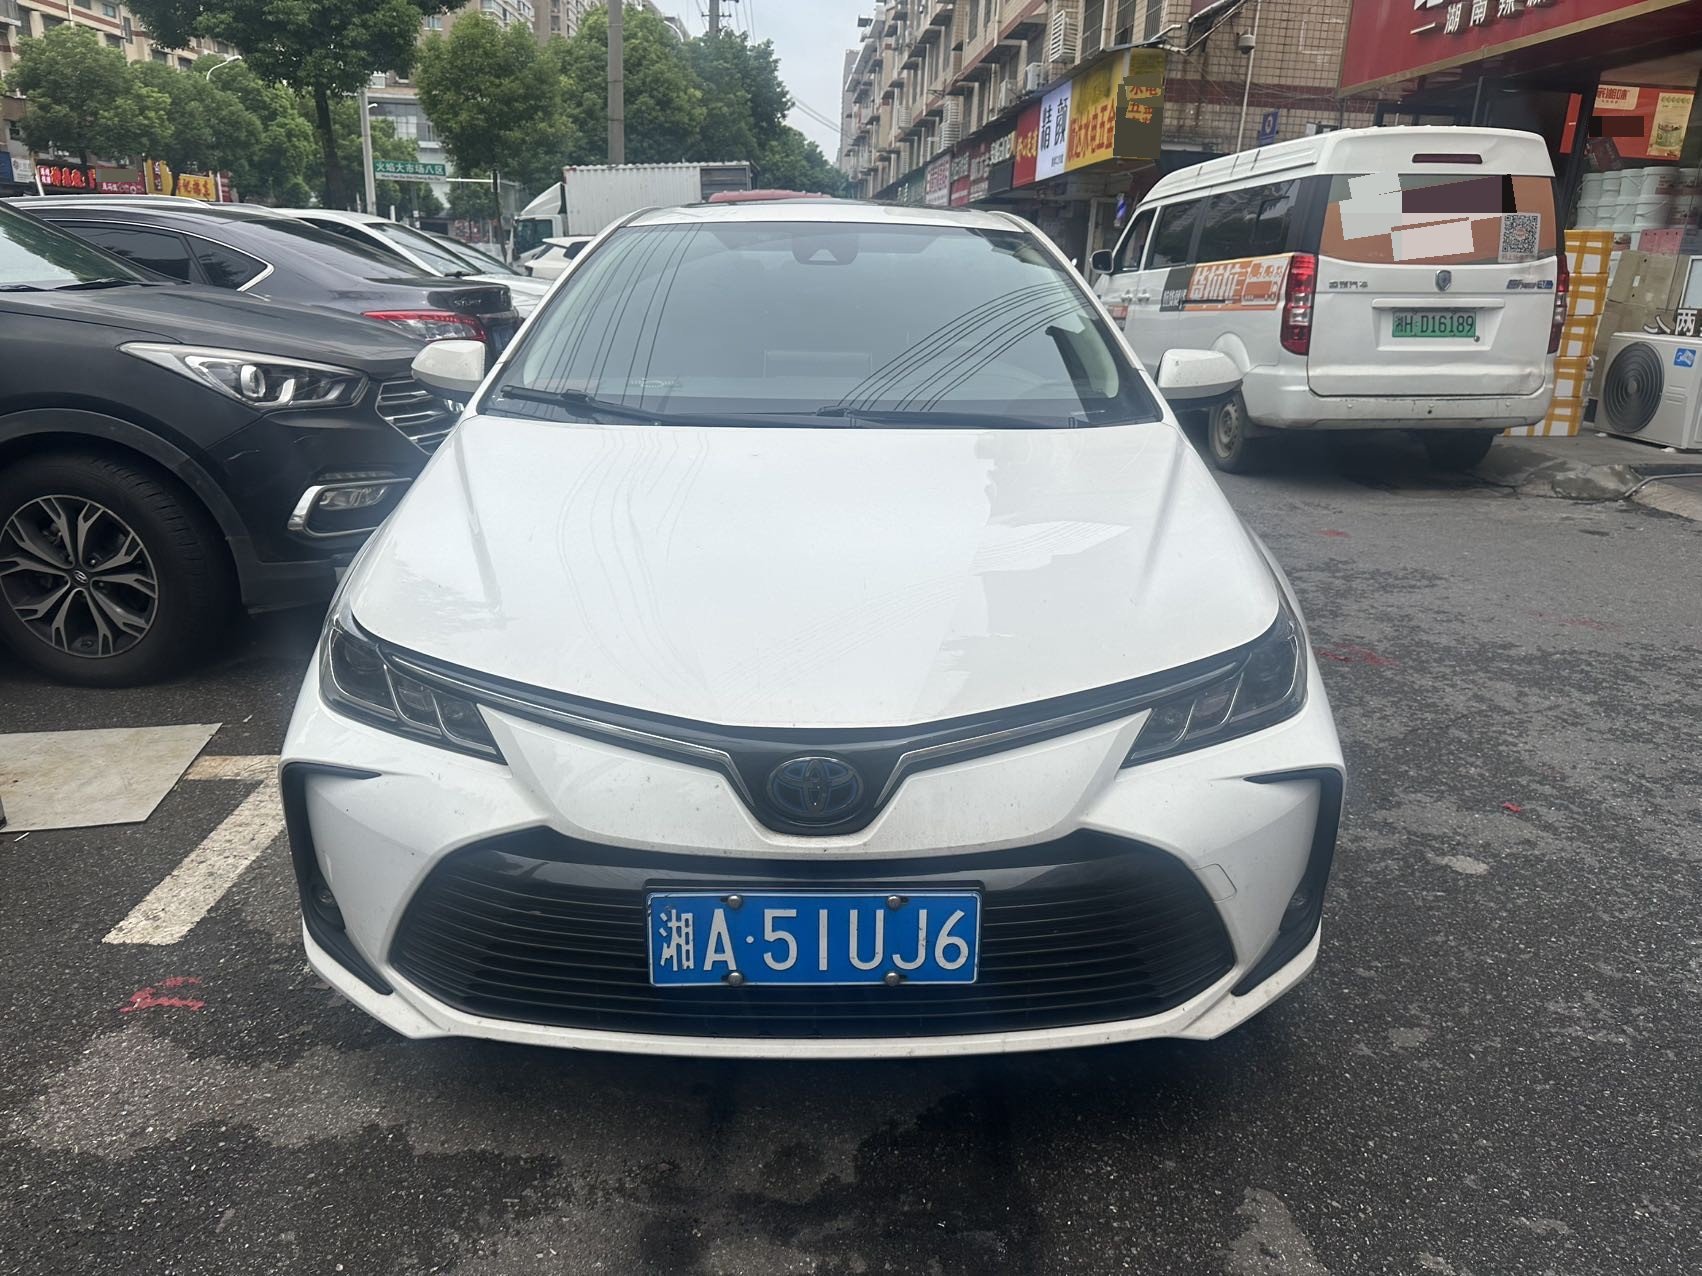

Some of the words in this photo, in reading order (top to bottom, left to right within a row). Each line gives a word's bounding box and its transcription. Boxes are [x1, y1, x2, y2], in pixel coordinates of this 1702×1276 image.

[376, 161, 444, 175] 火焰大市场八区
[1190, 264, 1240, 301] 货拉拉
